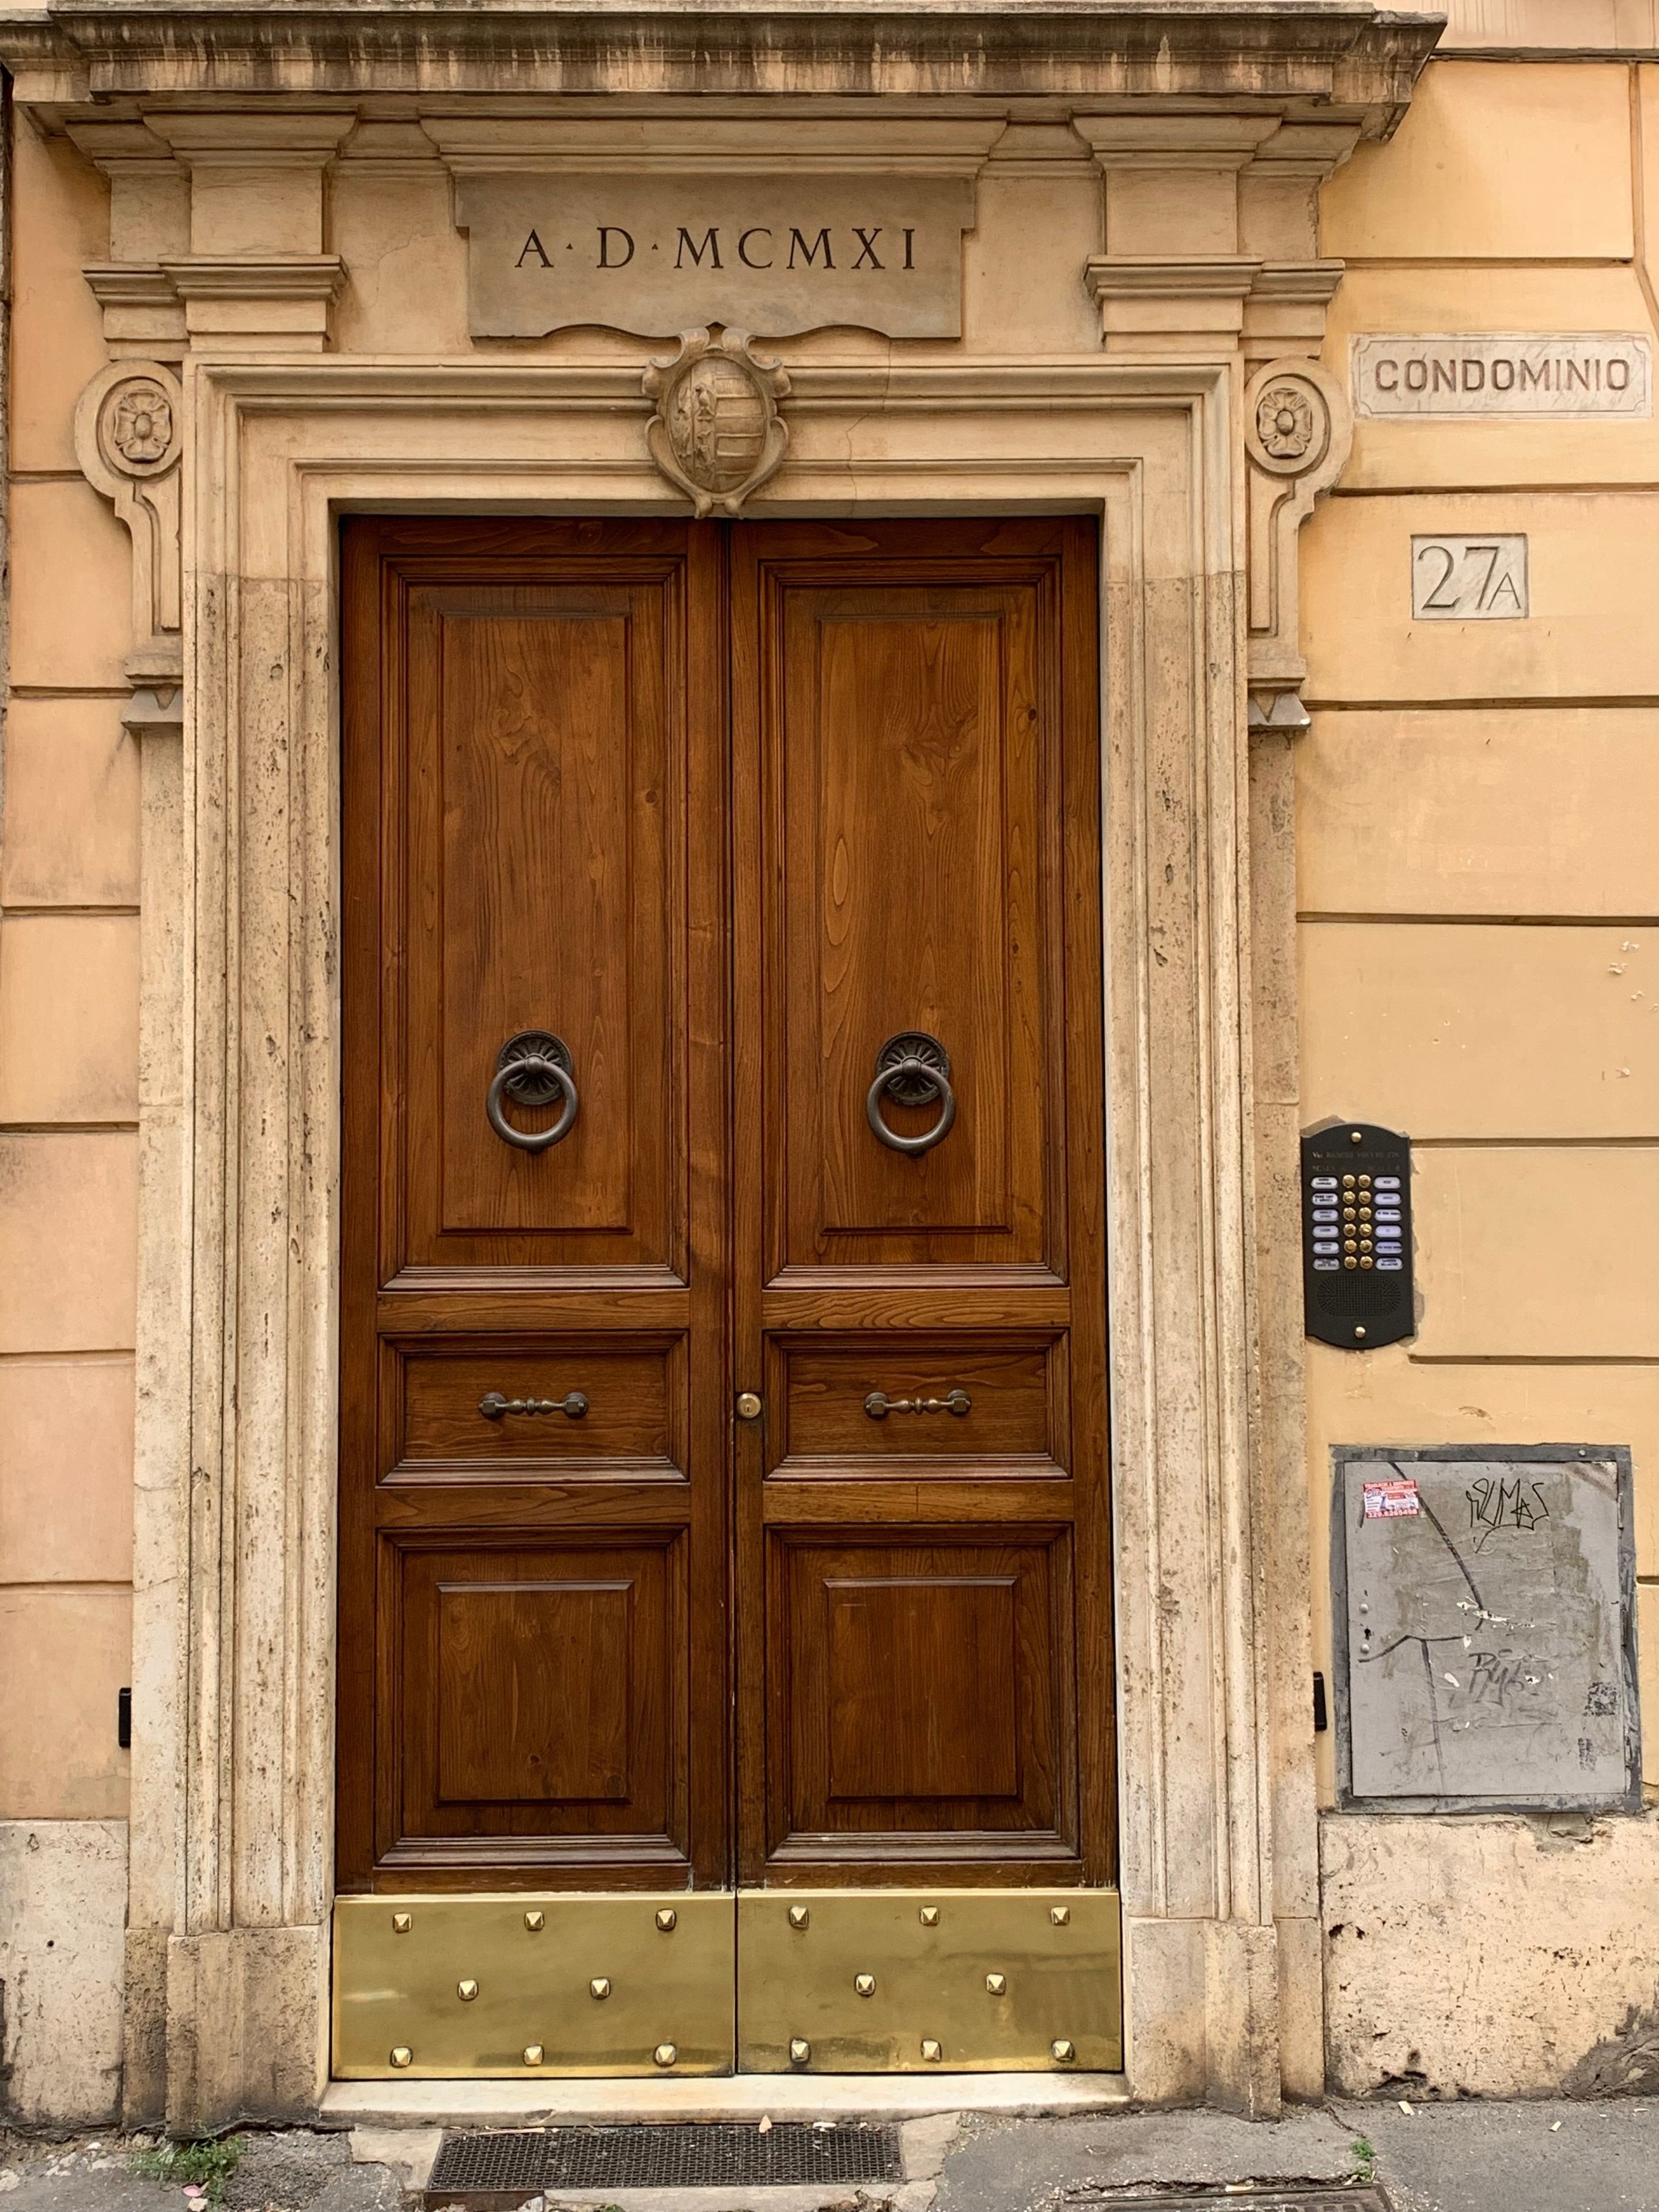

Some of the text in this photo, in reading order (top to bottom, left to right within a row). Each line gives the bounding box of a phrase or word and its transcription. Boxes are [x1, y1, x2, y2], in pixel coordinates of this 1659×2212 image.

[673, 227, 916, 270] MCMXI
[1374, 359, 1630, 393] CONDOMINIO
[1416, 545, 1522, 611] 27A
